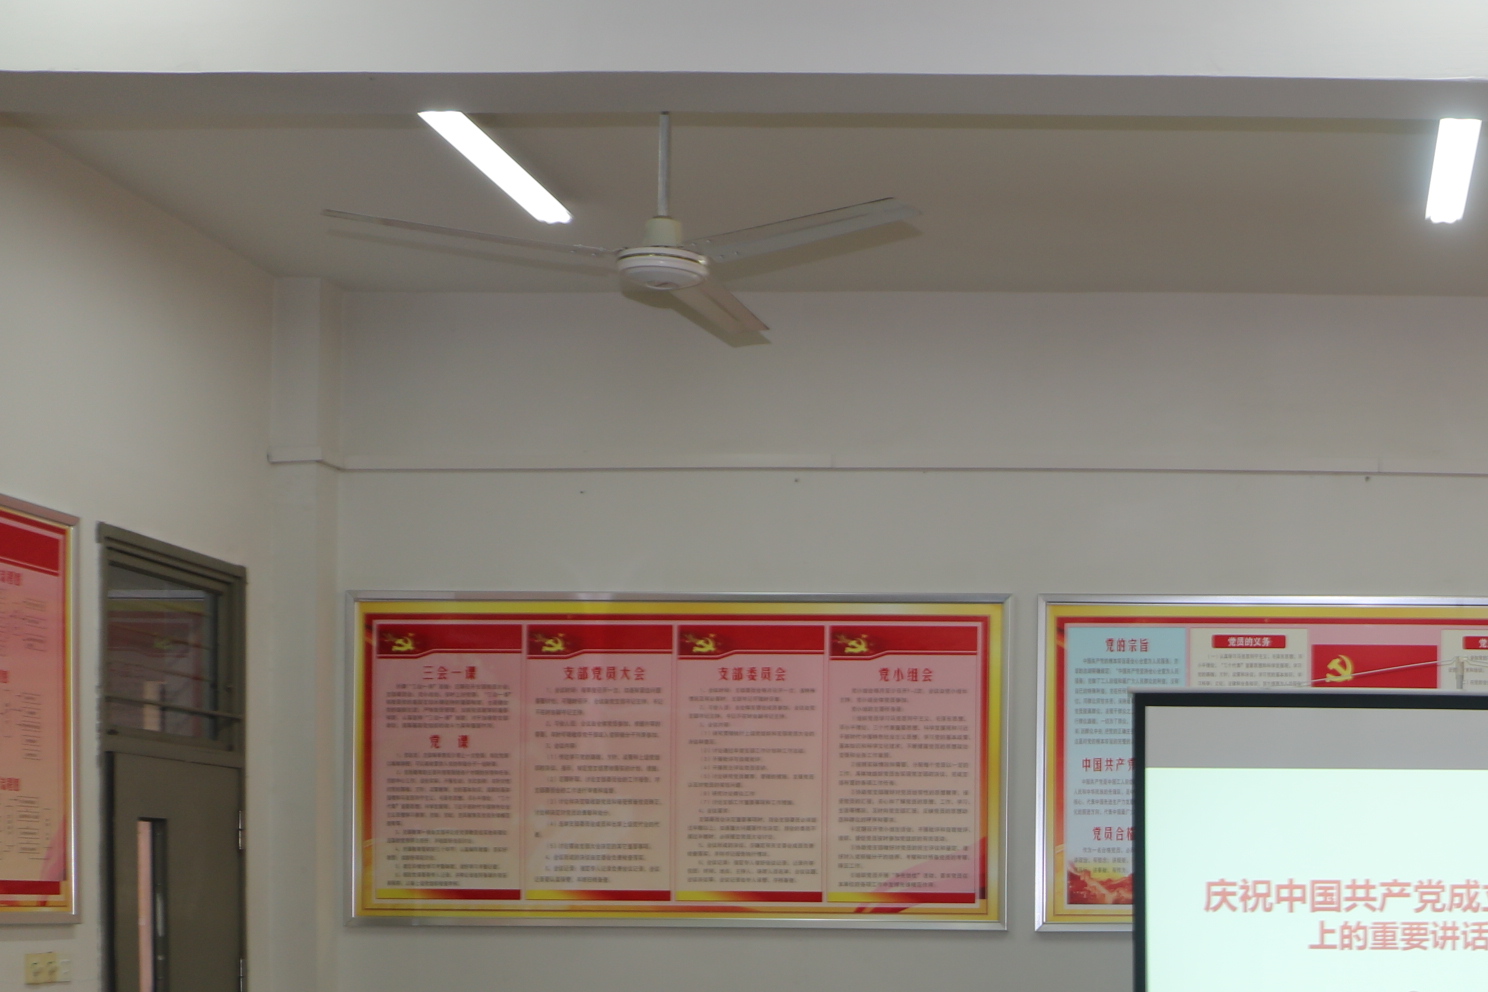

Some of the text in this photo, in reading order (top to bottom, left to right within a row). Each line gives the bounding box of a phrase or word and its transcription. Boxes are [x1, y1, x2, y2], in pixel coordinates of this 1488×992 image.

[1105, 638, 1150, 653] 党的宗旨
[1227, 637, 1271, 648] 党员的义务
[423, 666, 477, 680] 三会一课
[564, 666, 646, 681] 支部党员大会
[718, 667, 786, 682] 支部委员会
[878, 667, 933, 682] 党小组会
